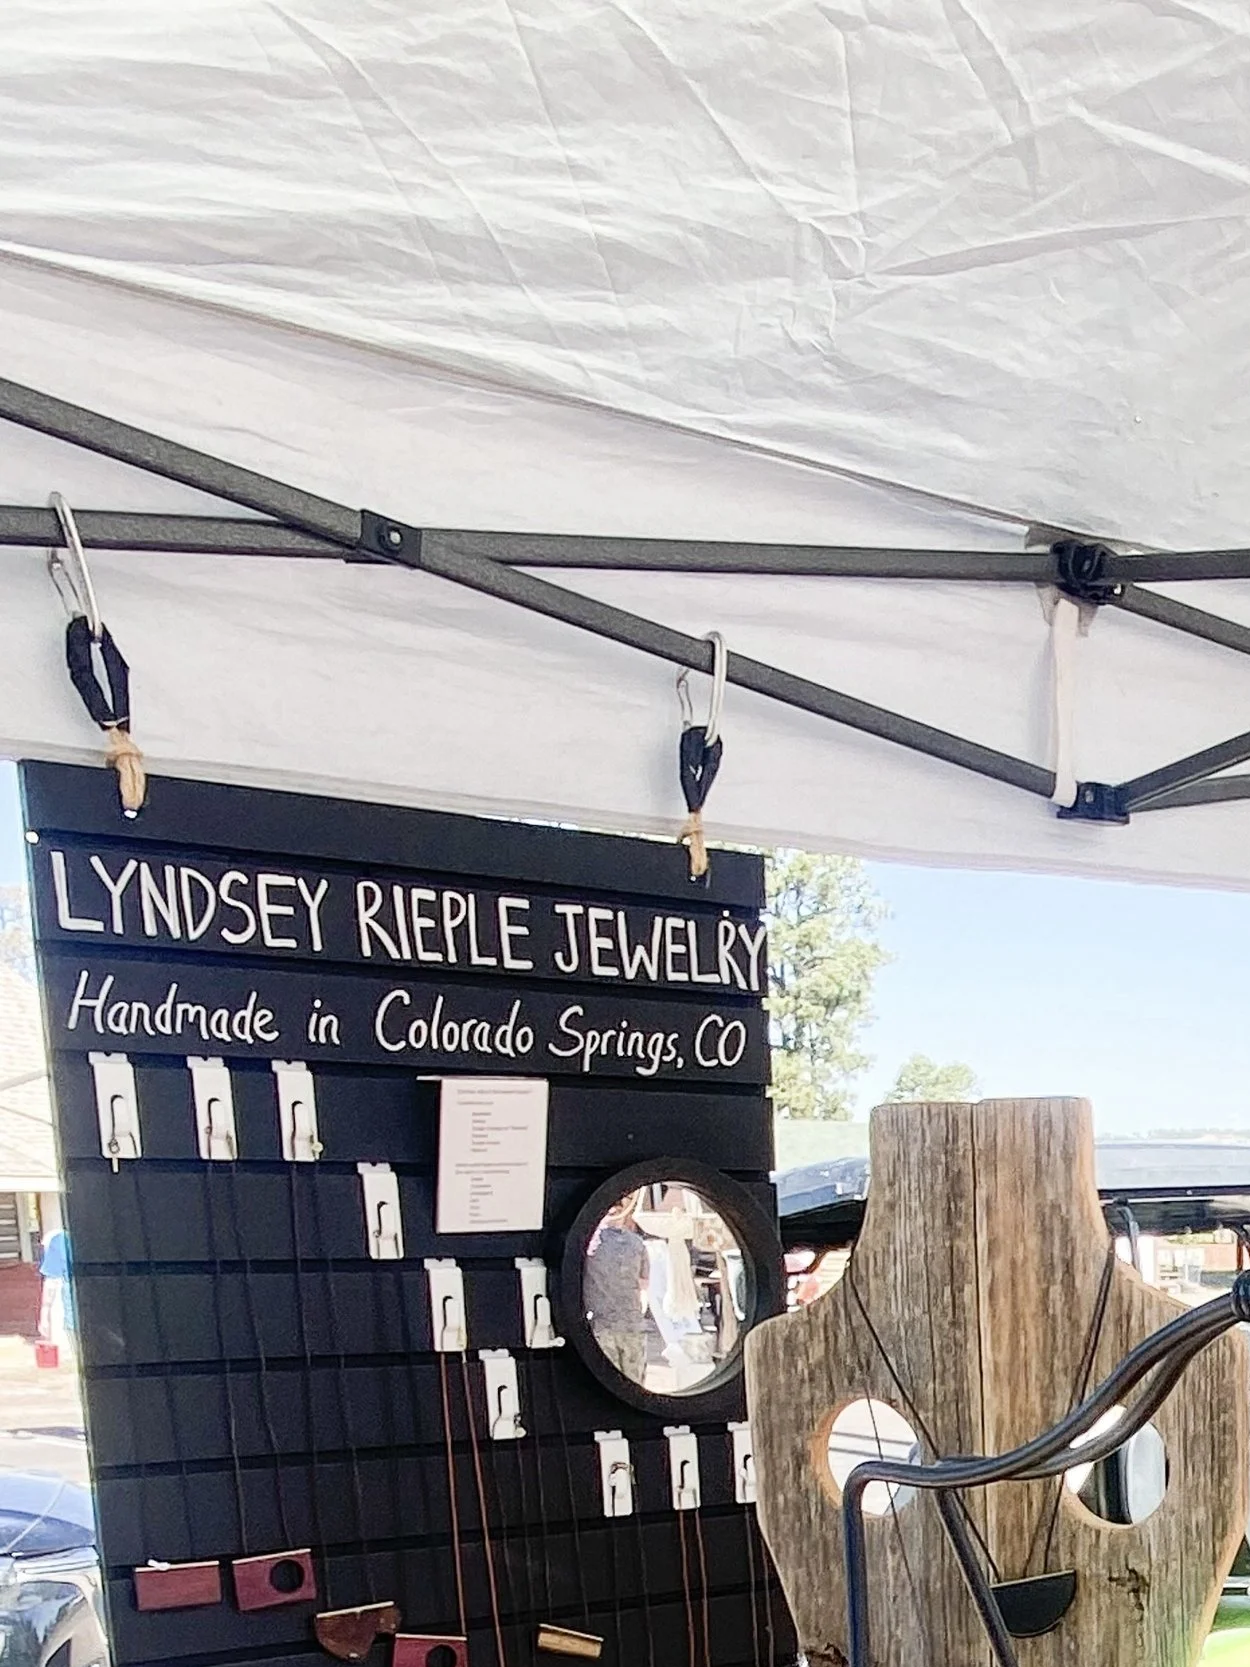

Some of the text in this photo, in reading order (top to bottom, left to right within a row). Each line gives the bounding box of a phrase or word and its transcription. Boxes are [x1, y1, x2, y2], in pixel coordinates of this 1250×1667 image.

[50, 850, 767, 992] LYNDSEY RIEPLE JEWELRY
[66, 970, 747, 1076] Handmade in Colorado Springs, CO
